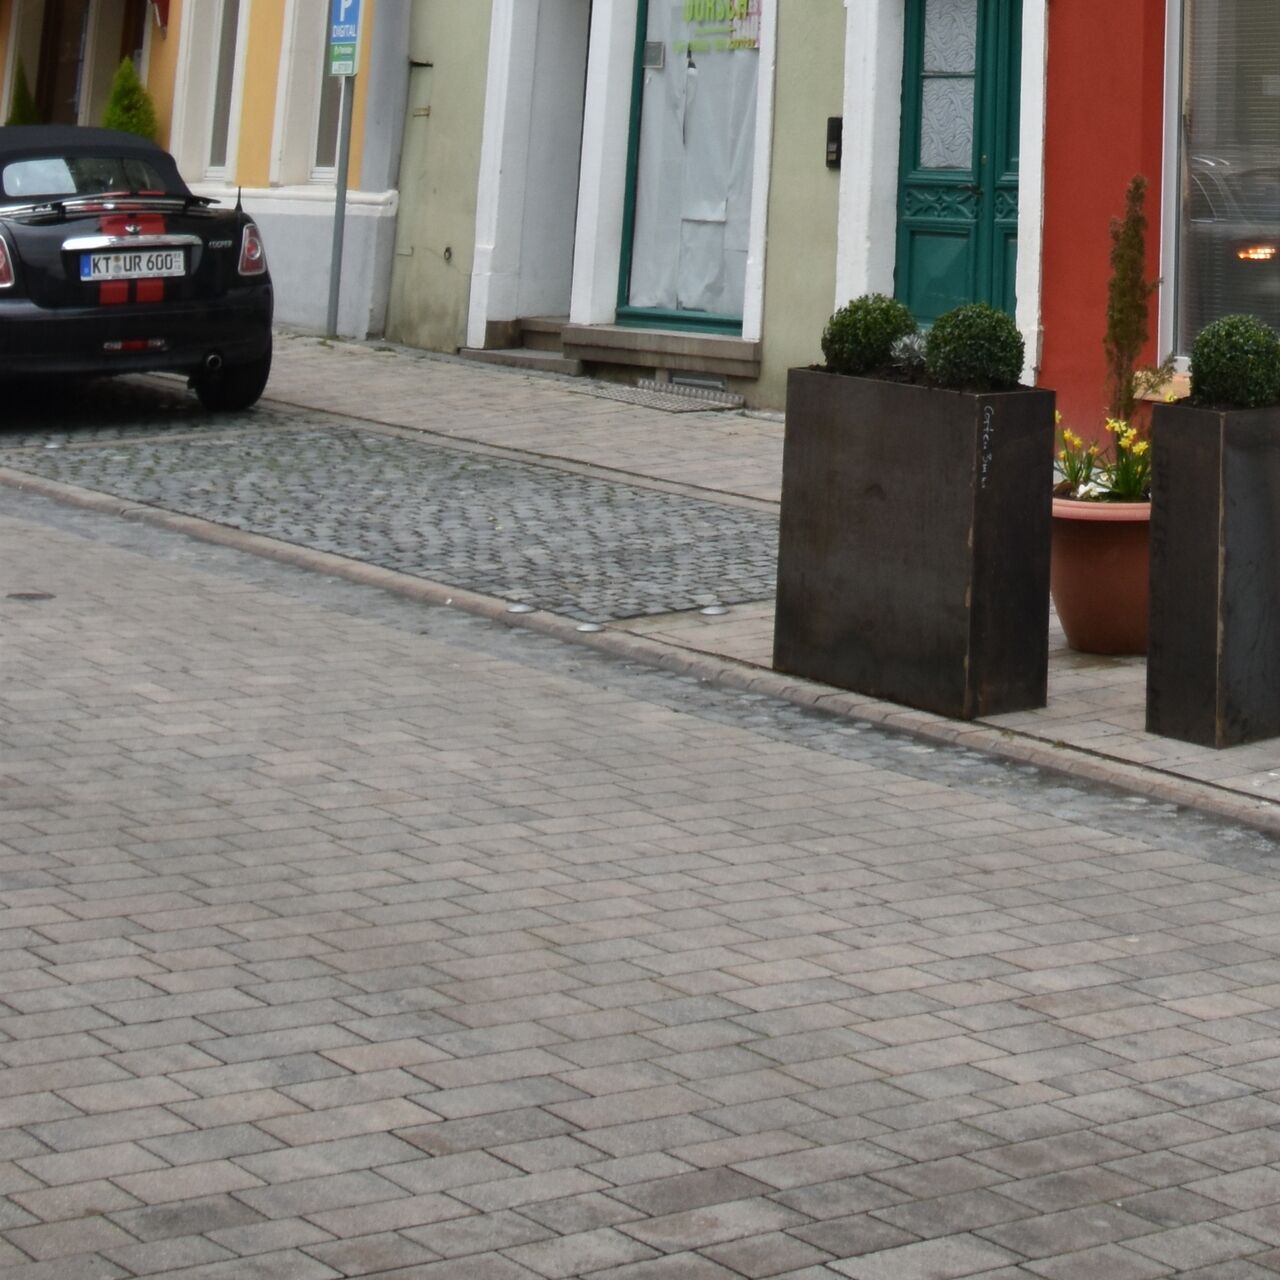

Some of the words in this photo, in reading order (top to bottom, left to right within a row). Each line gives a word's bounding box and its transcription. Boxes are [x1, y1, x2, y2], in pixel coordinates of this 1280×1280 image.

[92, 256, 112, 274] KT
[123, 255, 142, 272] UR
[146, 253, 173, 271] 600
